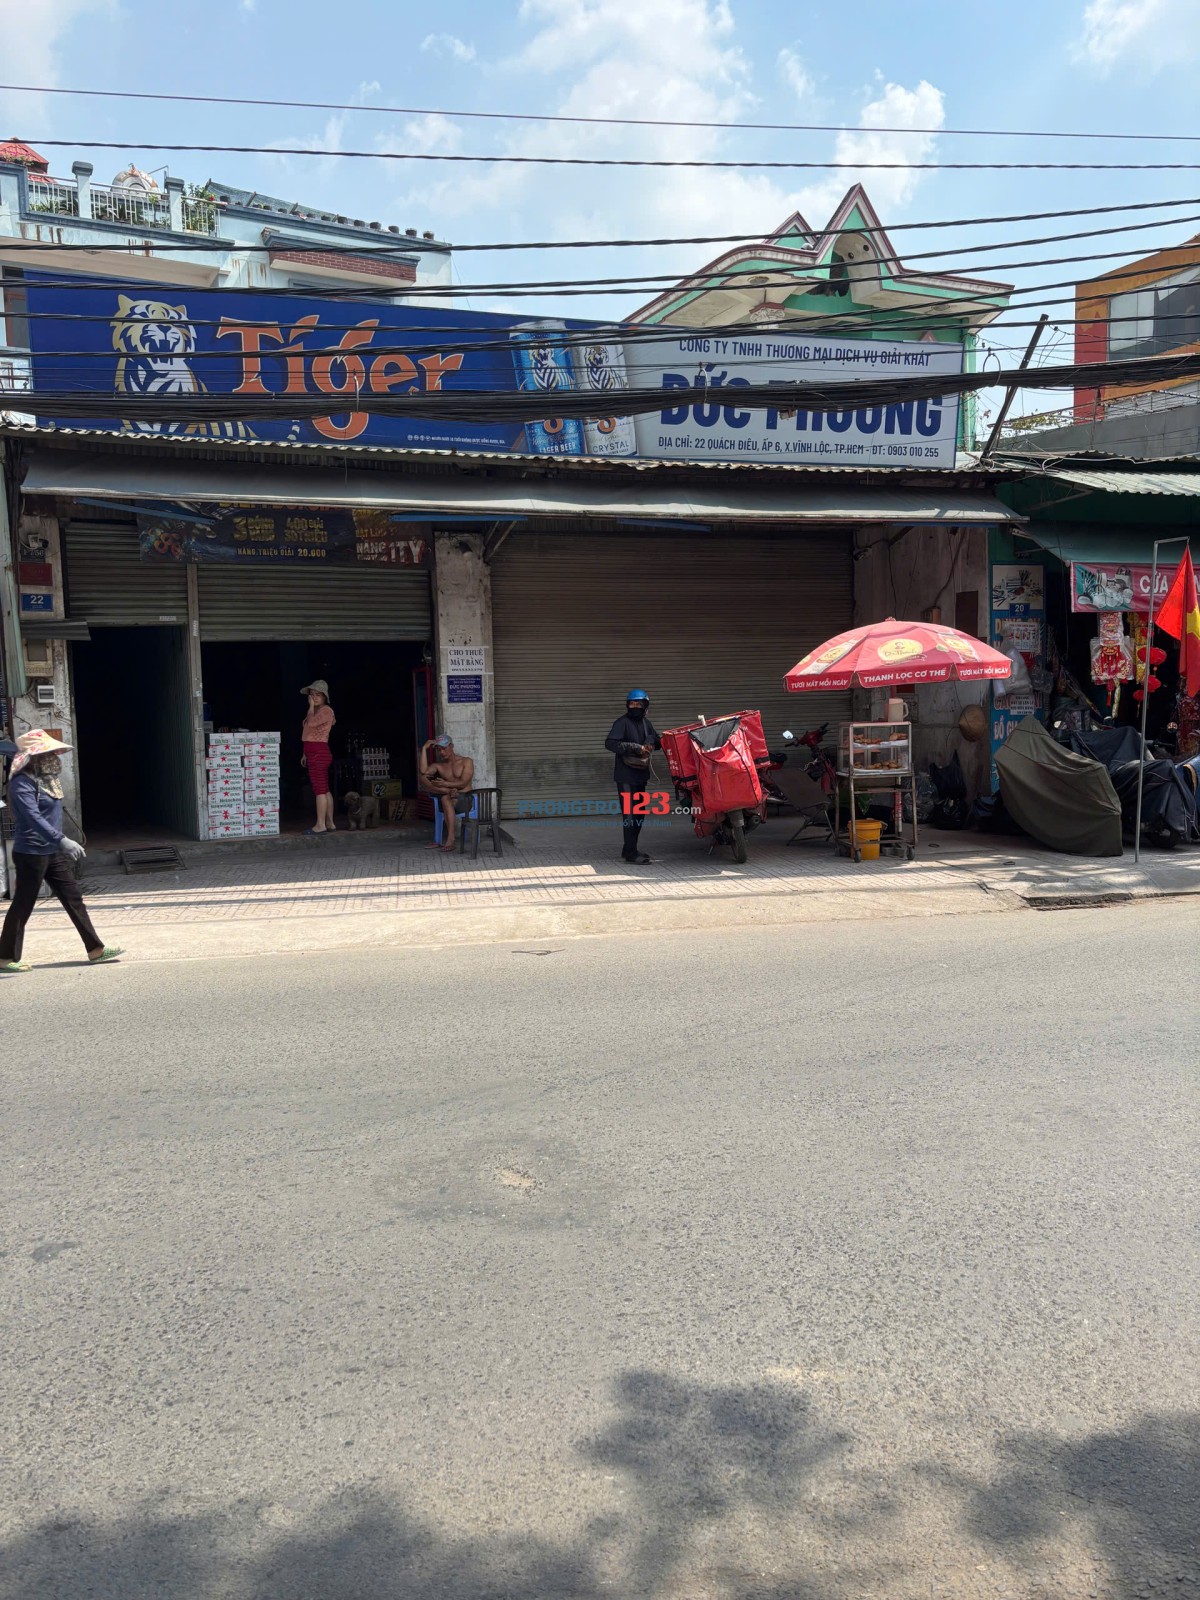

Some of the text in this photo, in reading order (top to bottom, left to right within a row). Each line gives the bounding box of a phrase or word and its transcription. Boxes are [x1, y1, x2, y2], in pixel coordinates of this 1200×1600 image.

[714, 340, 728, 354] TY
[732, 341, 762, 357] TNHH
[766, 343, 810, 360] THƯƠNG
[813, 346, 832, 364] MẠI
[835, 348, 860, 365] DỊCH
[863, 350, 877, 367] VỤ
[880, 347, 901, 365] GIẢI
[904, 350, 931, 366] KHÁT
[216, 314, 465, 440] Tiger
[660, 362, 751, 429] ĐỨC
[561, 442, 577, 452] BEER
[592, 441, 630, 453] CRYSTAL
[658, 436, 673, 450] ĐỊA
[675, 434, 692, 449] CHỈ:
[694, 438, 706, 449] 22
[707, 437, 736, 450] QUÁCH
[761, 437, 773, 452] ẤP
[775, 441, 783, 453] 6,
[785, 439, 813, 453] X.VĨNH
[814, 441, 833, 456] LỘC,
[834, 443, 864, 455] TP.HCM
[872, 445, 886, 455] ĐT:
[887, 445, 908, 456] 0903
[909, 446, 923, 457] 010
[924, 447, 939, 458] 255
[297, 548, 327, 558] 20.000
[30, 595, 45, 605] 22
[1014, 604, 1025, 612] 20
[465, 648, 483, 656] THUÊ
[863, 666, 947, 683] THANH LỌC CƠ THỂ
[959, 669, 973, 677] TƯƠI
[791, 681, 806, 690] TƯƠI
[806, 679, 819, 688] MÁT
[373, 783, 386, 796] C2
